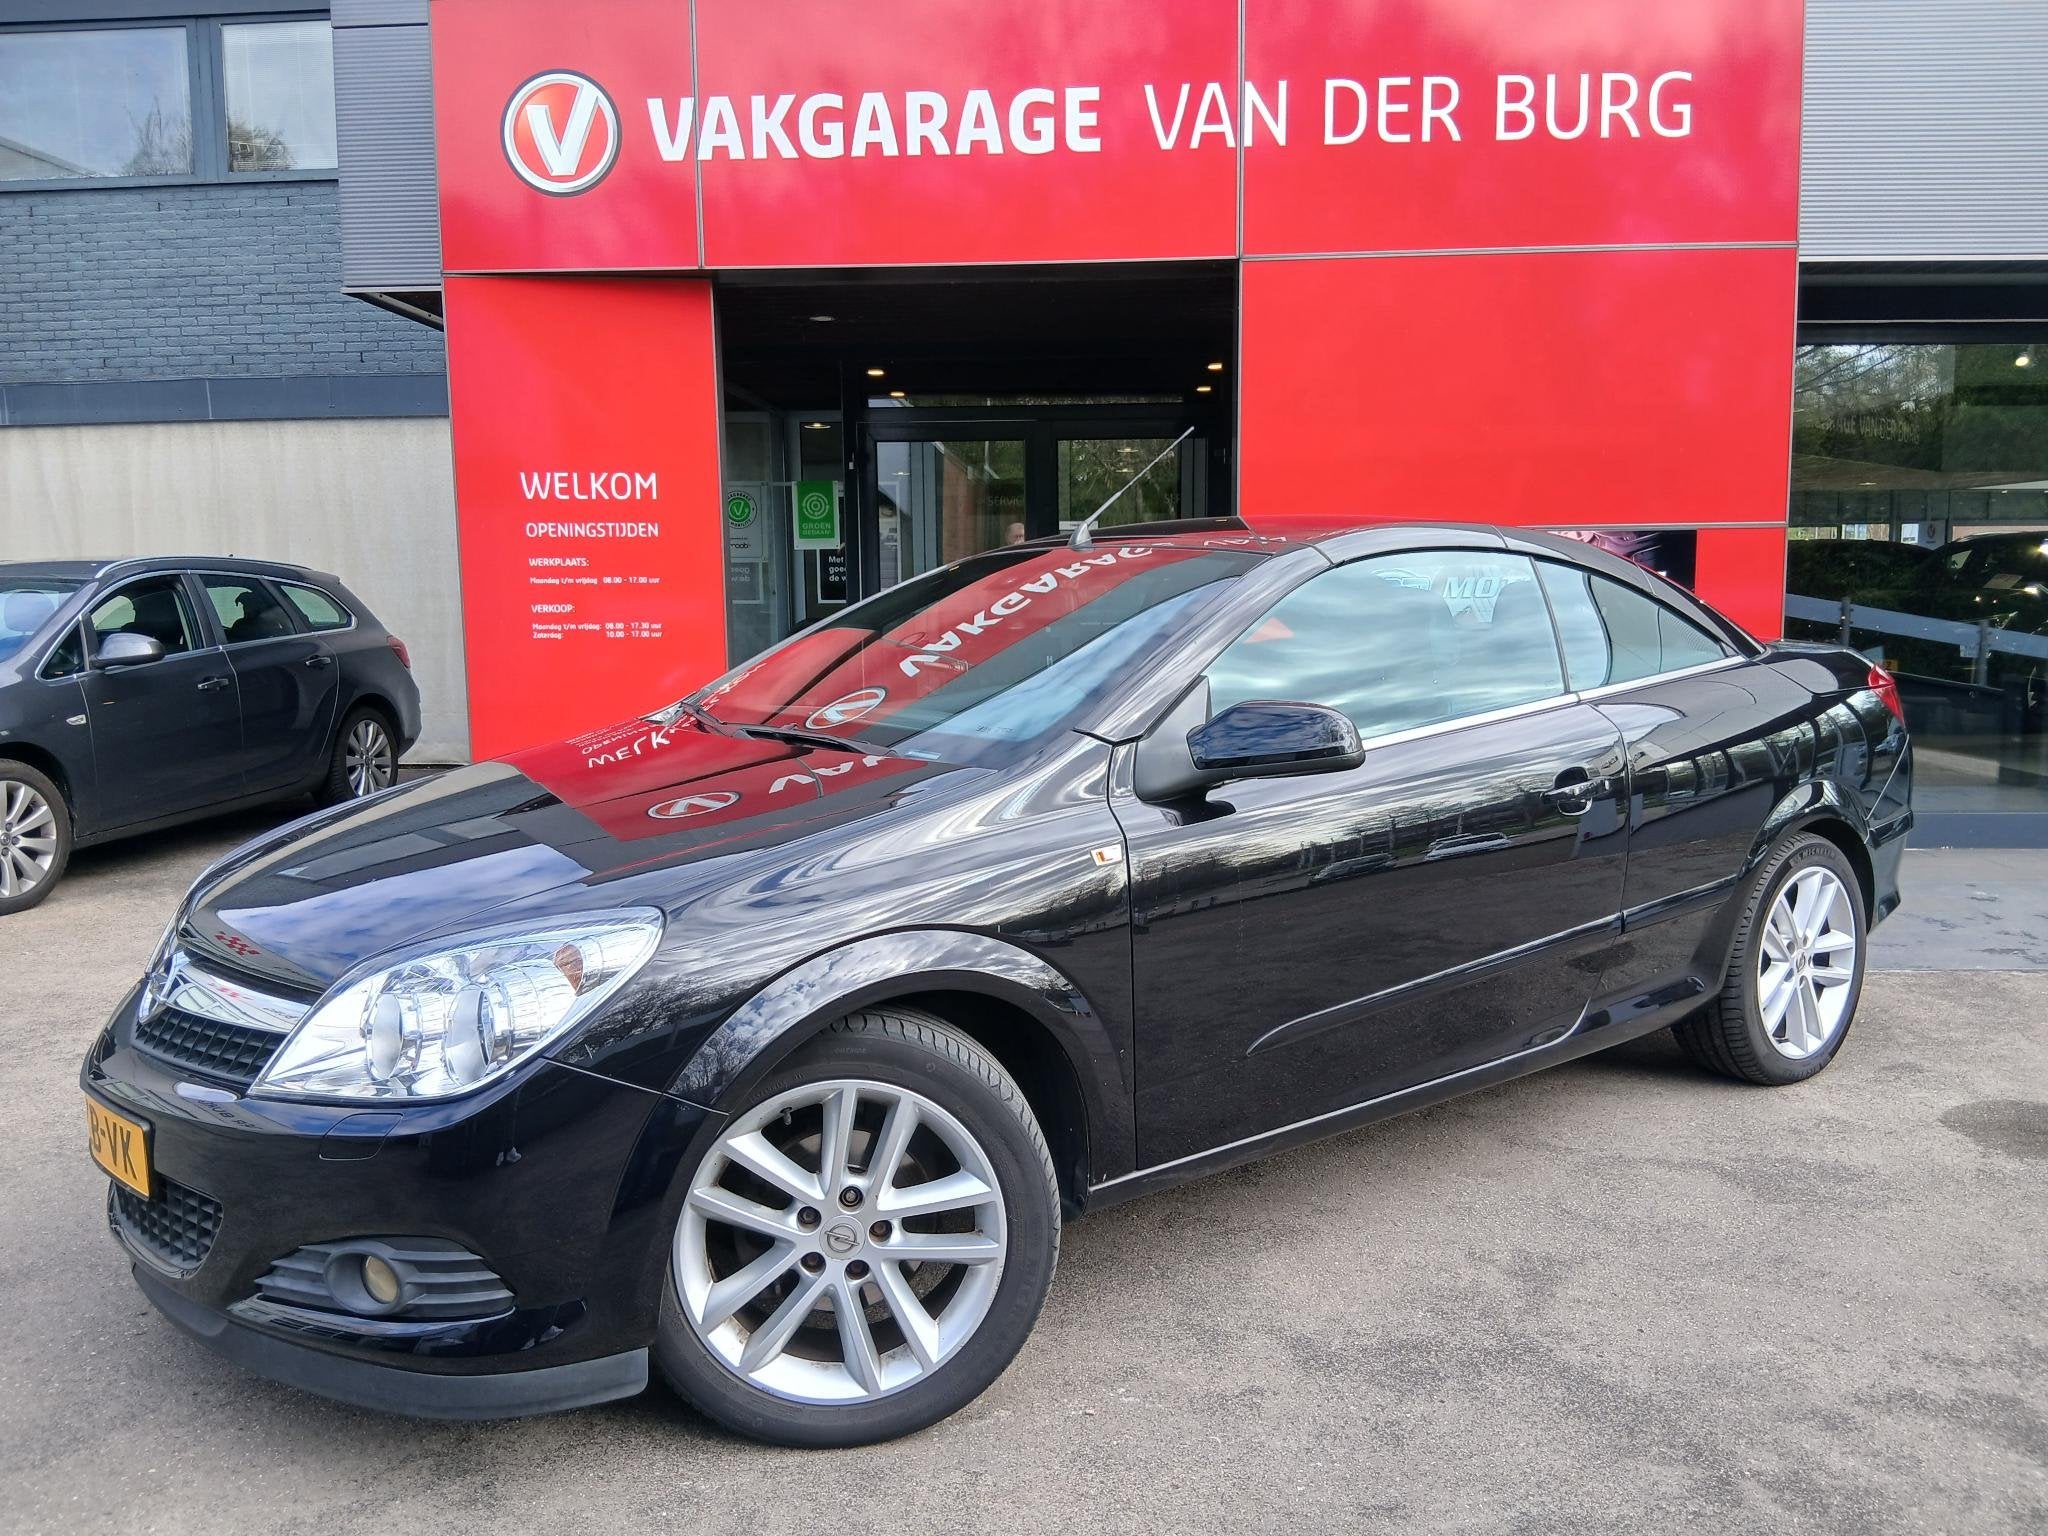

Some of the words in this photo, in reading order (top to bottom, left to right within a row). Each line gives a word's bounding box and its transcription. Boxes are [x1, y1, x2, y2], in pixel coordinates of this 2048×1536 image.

[646, 86, 1101, 162] VAKGARAGE
[1144, 79, 1288, 150] VAN
[1323, 76, 1462, 146] DER
[1495, 70, 1693, 142] BURG
[519, 471, 658, 500] WELKOM
[525, 522, 660, 539] OPENINGSTIJDEN
[528, 557, 590, 567] WERKPLAATS:
[828, 566, 847, 575] goe
[602, 576, 622, 584] 08.00
[628, 576, 648, 584] 17.00
[531, 604, 576, 613] VERKOOP:
[604, 622, 625, 630] 08.00
